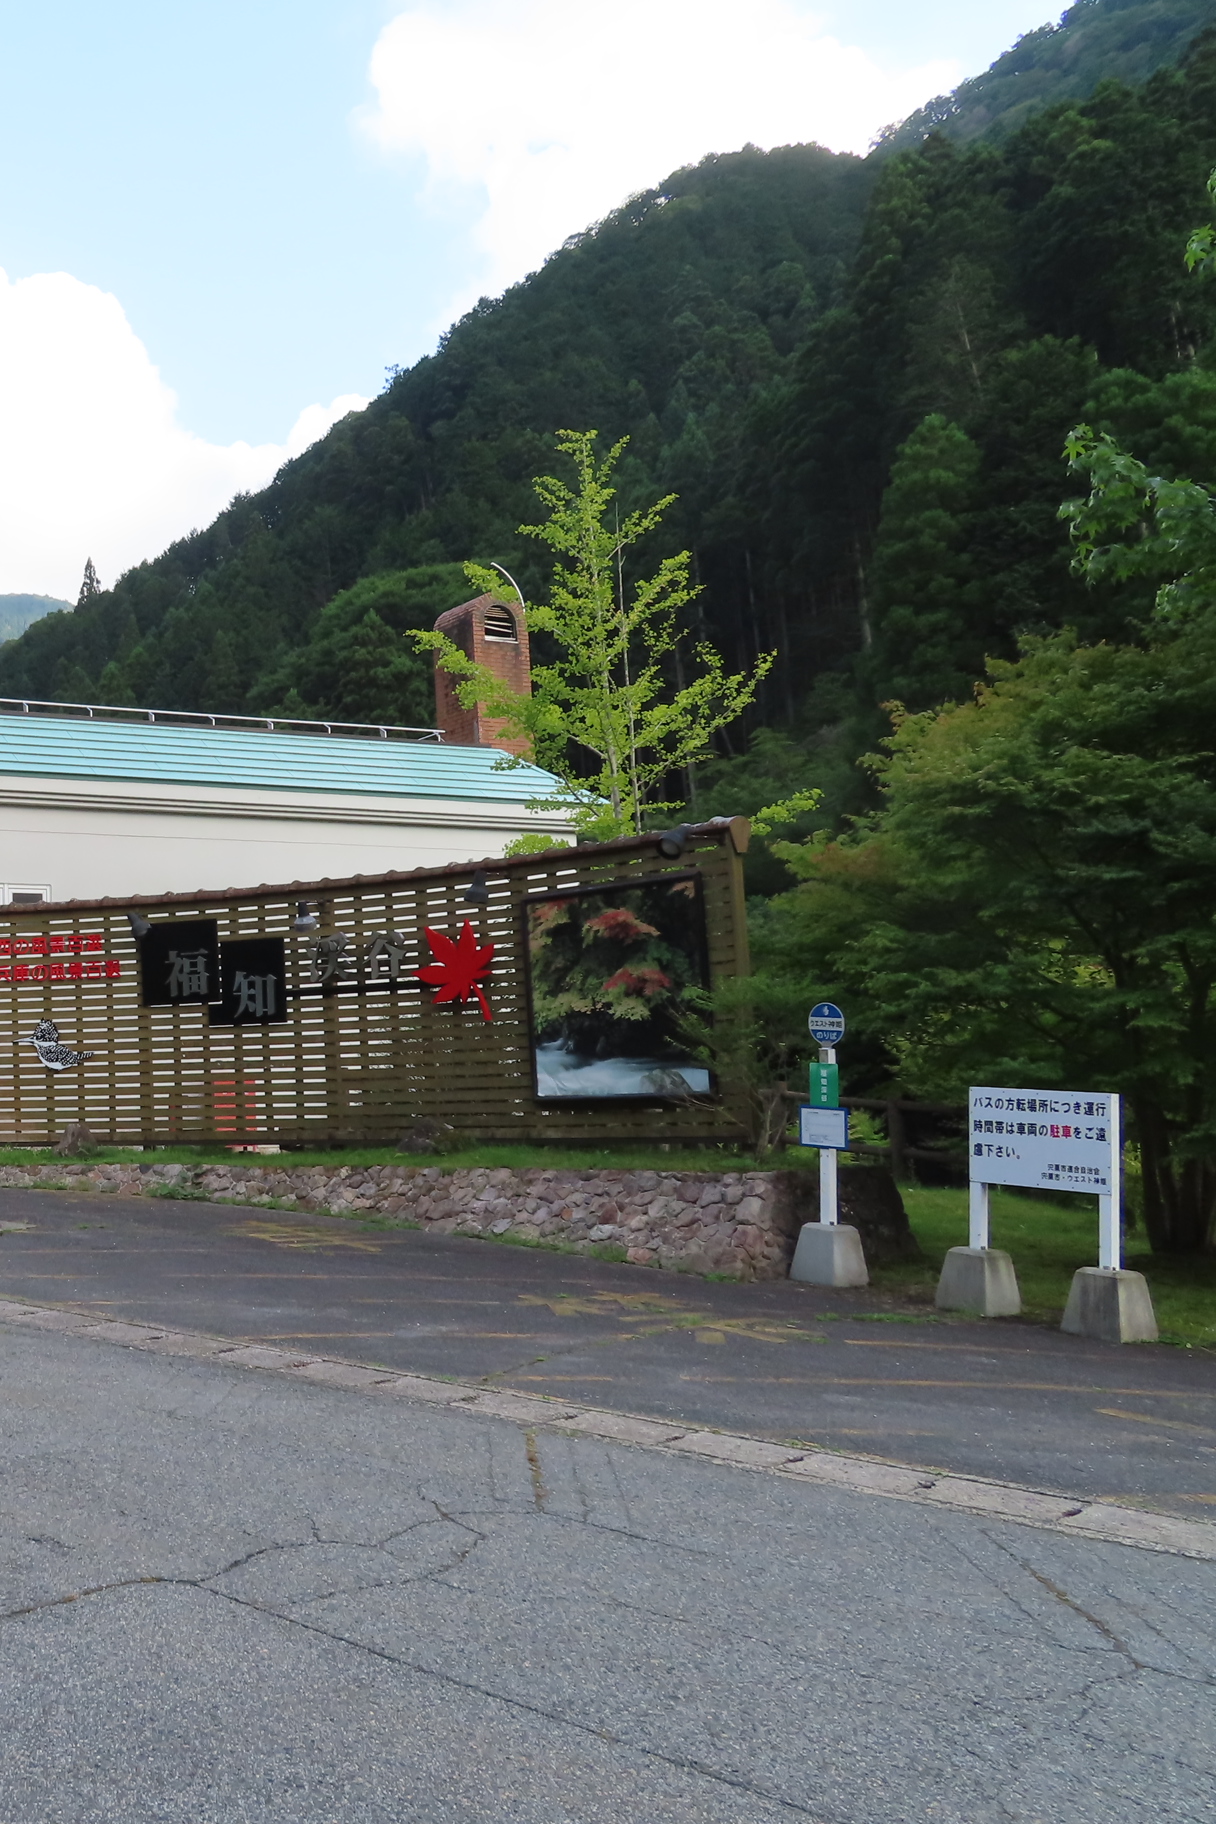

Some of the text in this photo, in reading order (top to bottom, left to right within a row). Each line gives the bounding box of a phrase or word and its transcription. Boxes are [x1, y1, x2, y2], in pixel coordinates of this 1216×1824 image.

[816, 1031, 838, 1040] のりば
[973, 1097, 1107, 1117] バスの方転場所につき運行
[973, 1120, 1107, 1142] 時間帯は車両の駐車をご遠
[973, 1143, 1021, 1160] 慮下さい。
